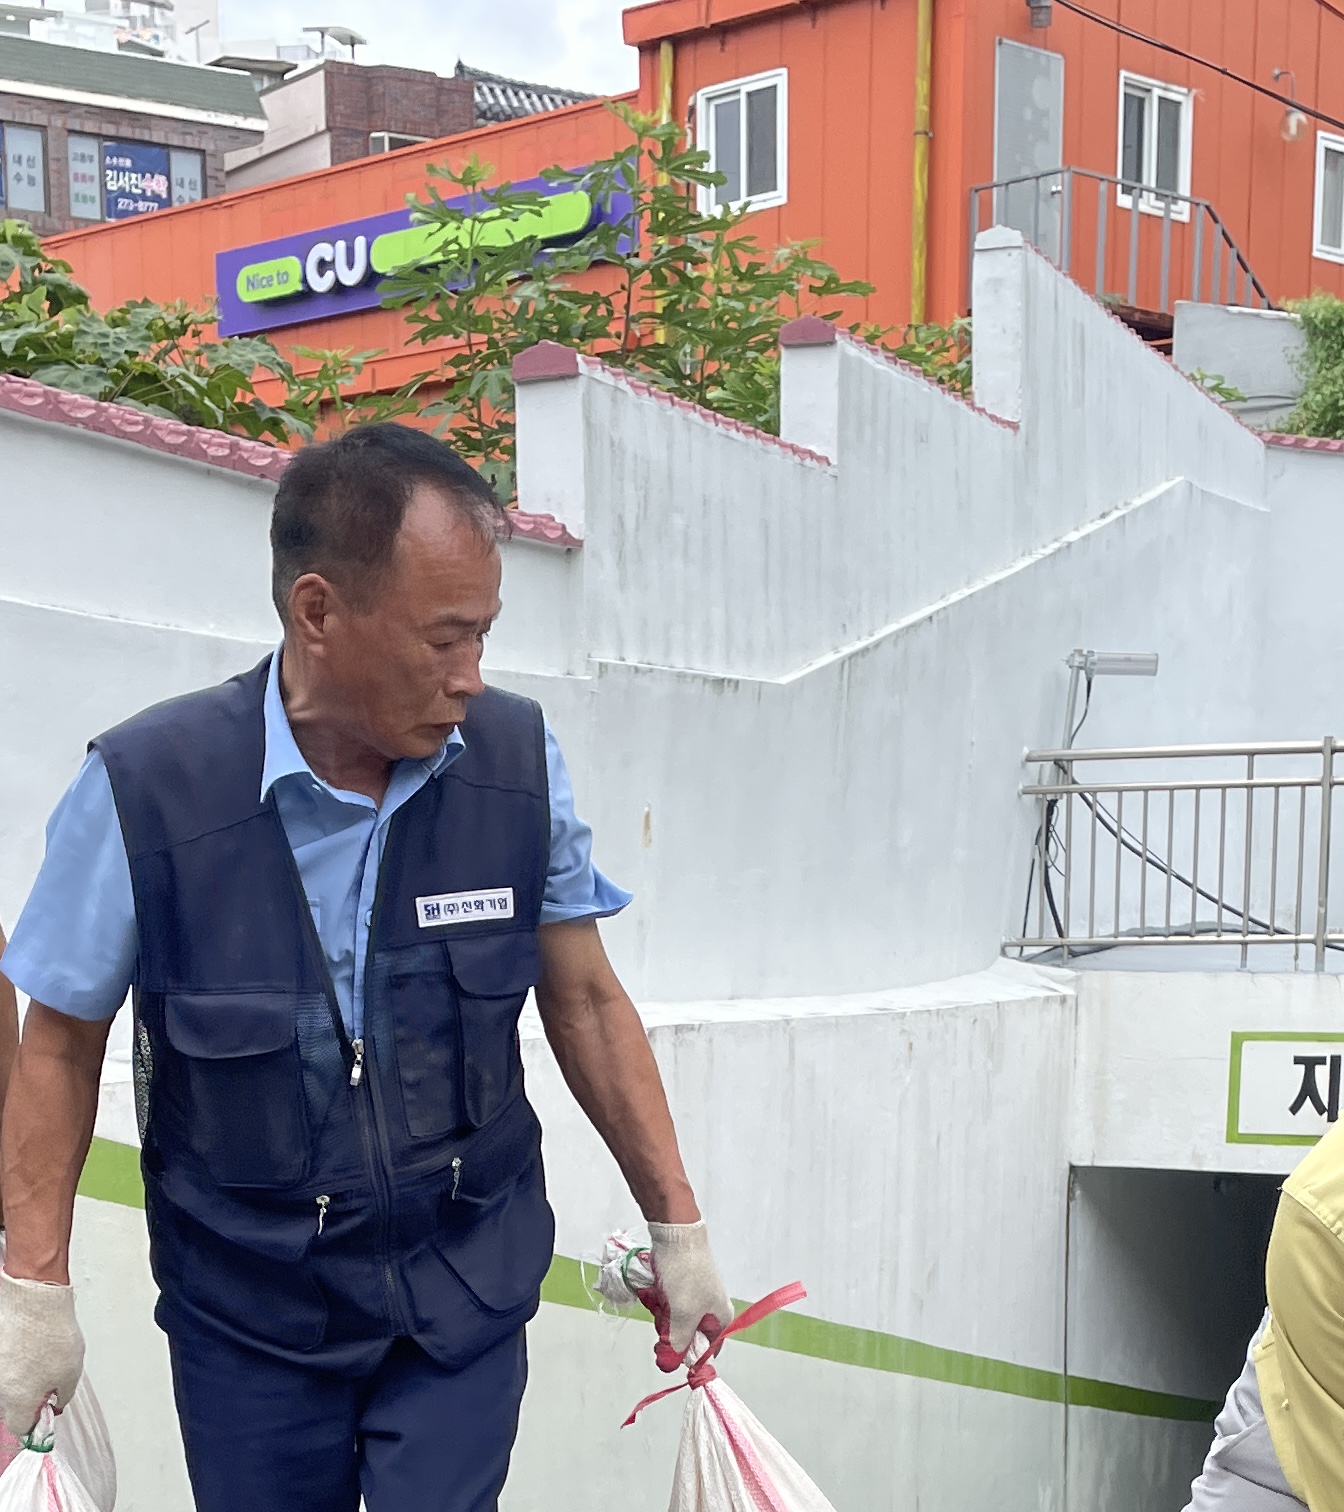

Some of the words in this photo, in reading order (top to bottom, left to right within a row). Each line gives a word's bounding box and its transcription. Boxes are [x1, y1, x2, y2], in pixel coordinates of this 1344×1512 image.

[105, 169, 168, 199] 김서진수학
[246, 272, 273, 292] Nice
[276, 270, 289, 285] to
[306, 235, 367, 293] CU
